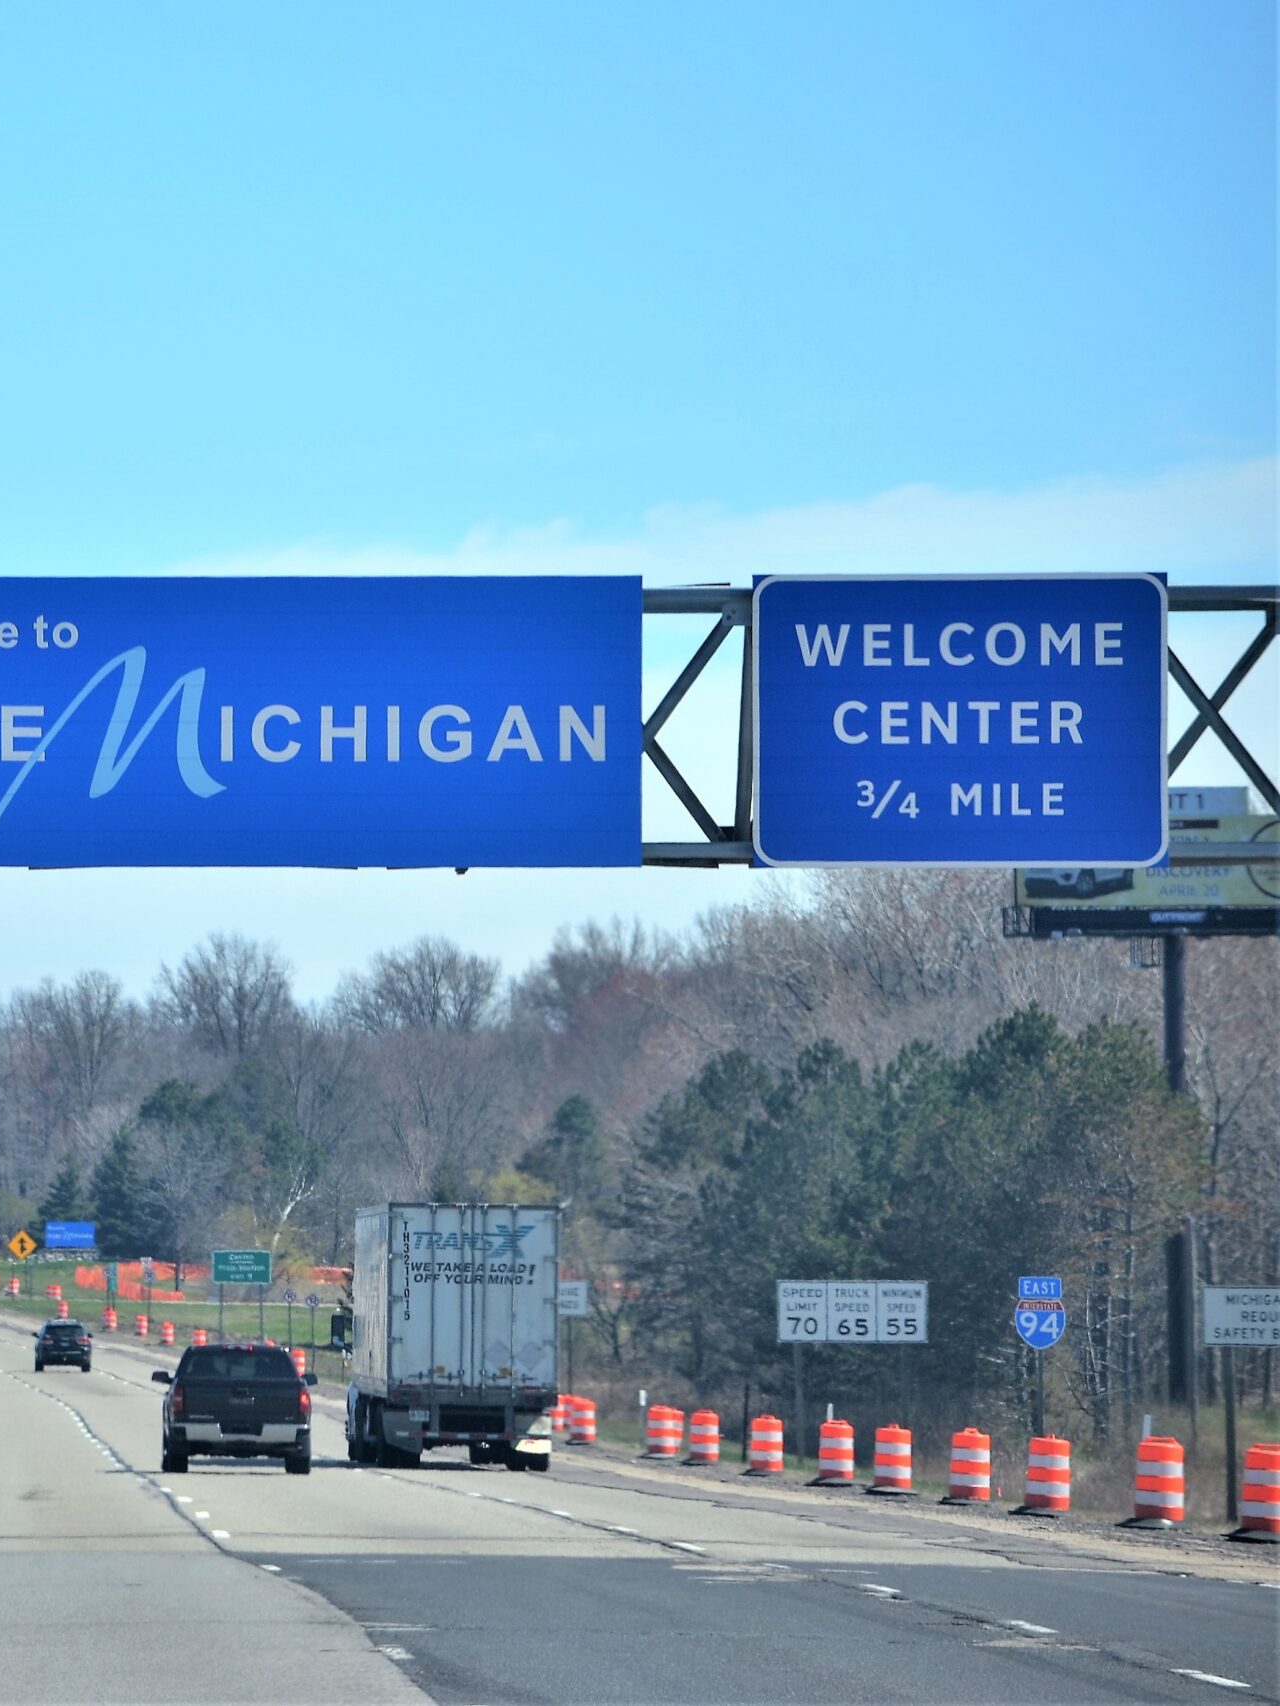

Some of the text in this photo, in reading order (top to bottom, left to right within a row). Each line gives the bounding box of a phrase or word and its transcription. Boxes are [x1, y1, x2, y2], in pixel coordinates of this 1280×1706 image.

[32, 614, 80, 650] to
[795, 622, 1125, 667] WELCOME
[832, 700, 1084, 745] CENTER
[855, 779, 1065, 819] 3/4 MILE
[1168, 793, 1205, 809] IT 1
[1145, 866, 1231, 878] DISCOVERY
[1158, 884, 1196, 897] APRIL
[413, 1224, 536, 1259] TRANSX
[403, 1221, 411, 1321] TH3211015
[411, 1262, 431, 1273] WE
[436, 1262, 472, 1273] TAKE
[475, 1263, 485, 1273] A
[414, 1274, 440, 1283] OFF
[445, 1274, 484, 1285] YOUR
[782, 1288, 823, 1298] SPEED
[835, 1288, 869, 1298] TRUCK
[881, 1289, 922, 1299] MINIMUM
[1023, 1280, 1056, 1295] EAST
[1225, 1294, 1280, 1305] MICHIGA
[786, 1303, 819, 1312] LIMIT
[834, 1303, 869, 1312] SPEED
[887, 1303, 917, 1313] SPEED
[1241, 1311, 1280, 1322] REQU
[787, 1317, 818, 1335] 70
[838, 1319, 869, 1336] 65
[887, 1318, 917, 1336] 55
[1020, 1312, 1059, 1340] 94
[1214, 1327, 1265, 1339] SAFETY
